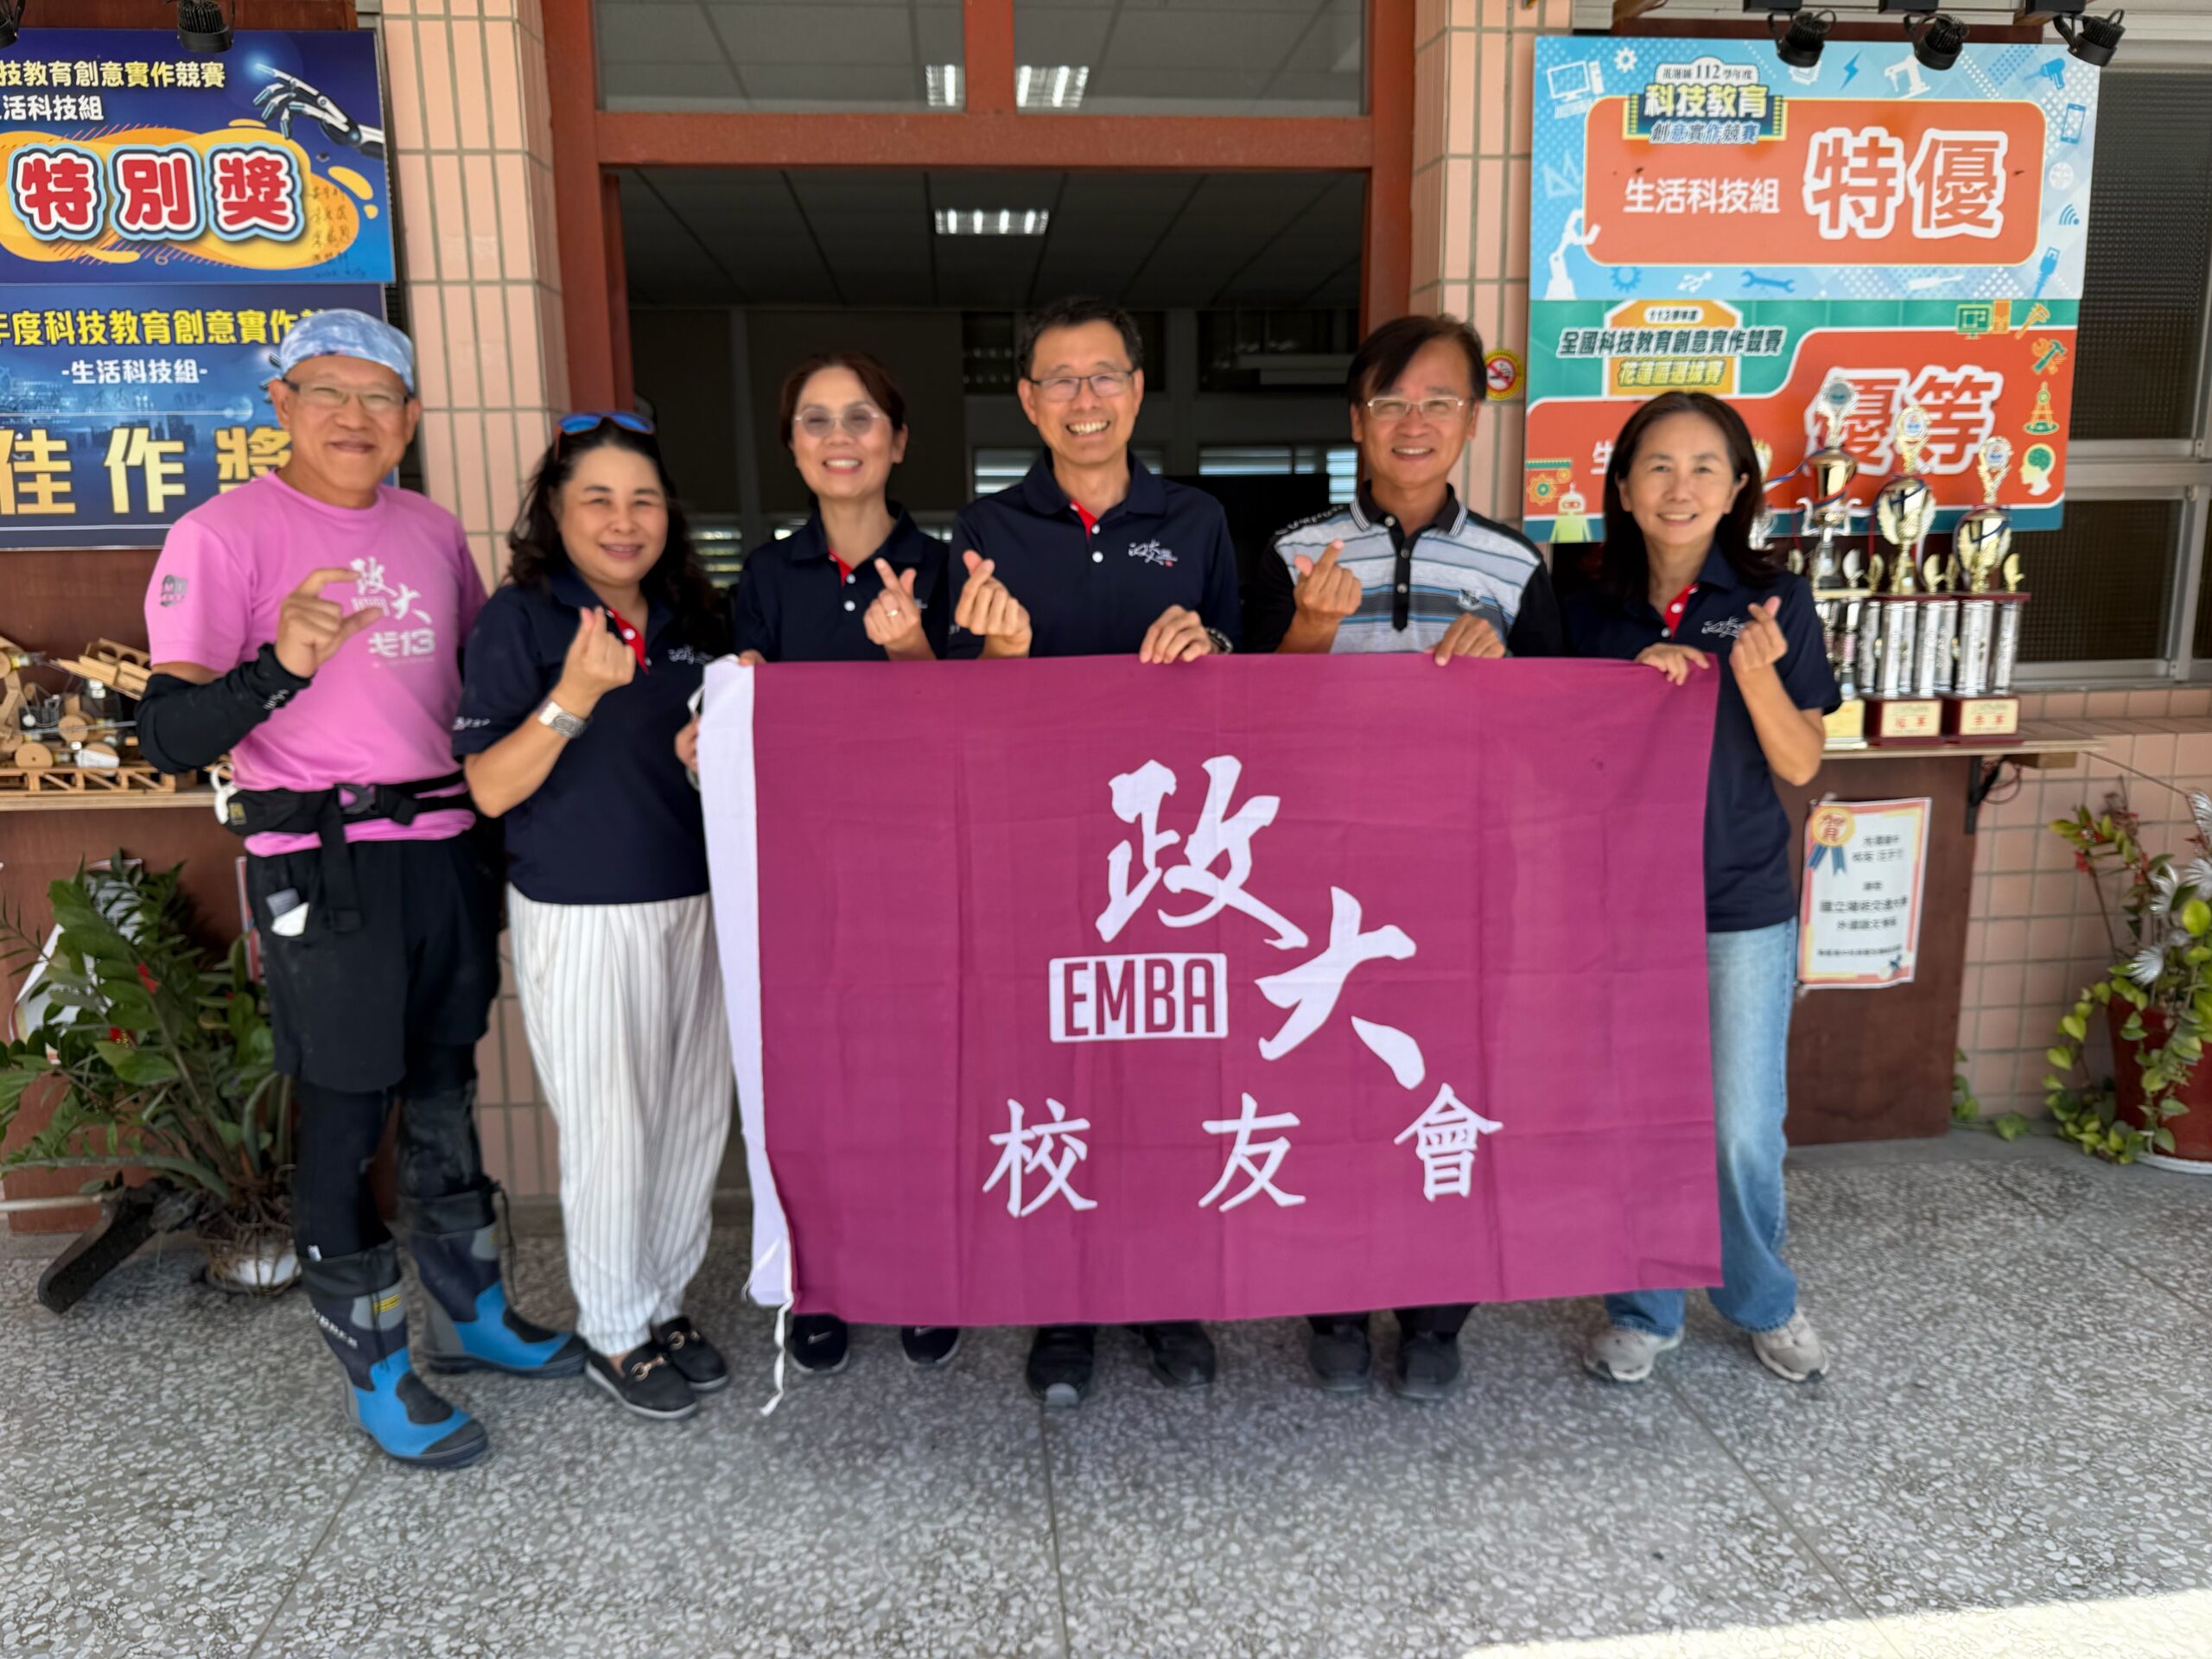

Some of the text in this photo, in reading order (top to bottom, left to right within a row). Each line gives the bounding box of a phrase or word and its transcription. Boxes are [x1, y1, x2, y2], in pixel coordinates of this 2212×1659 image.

[0, 60, 226, 87] 技教育創意實作競賽
[0, 93, 104, 121] 活科技組
[1644, 84, 1768, 118] 科技教育
[1650, 121, 1760, 143] 創意實作競賽
[15, 149, 299, 232] 特別獎
[1624, 177, 1780, 214] 生活科技組
[1803, 127, 2007, 239] 特優
[0, 308, 325, 345] 度科技教育創意實作
[1557, 326, 1787, 359] 全國科技教育創意實作競賽
[1063, 956, 1217, 1038] EMBA
[982, 1082, 1504, 1219] 校友會
